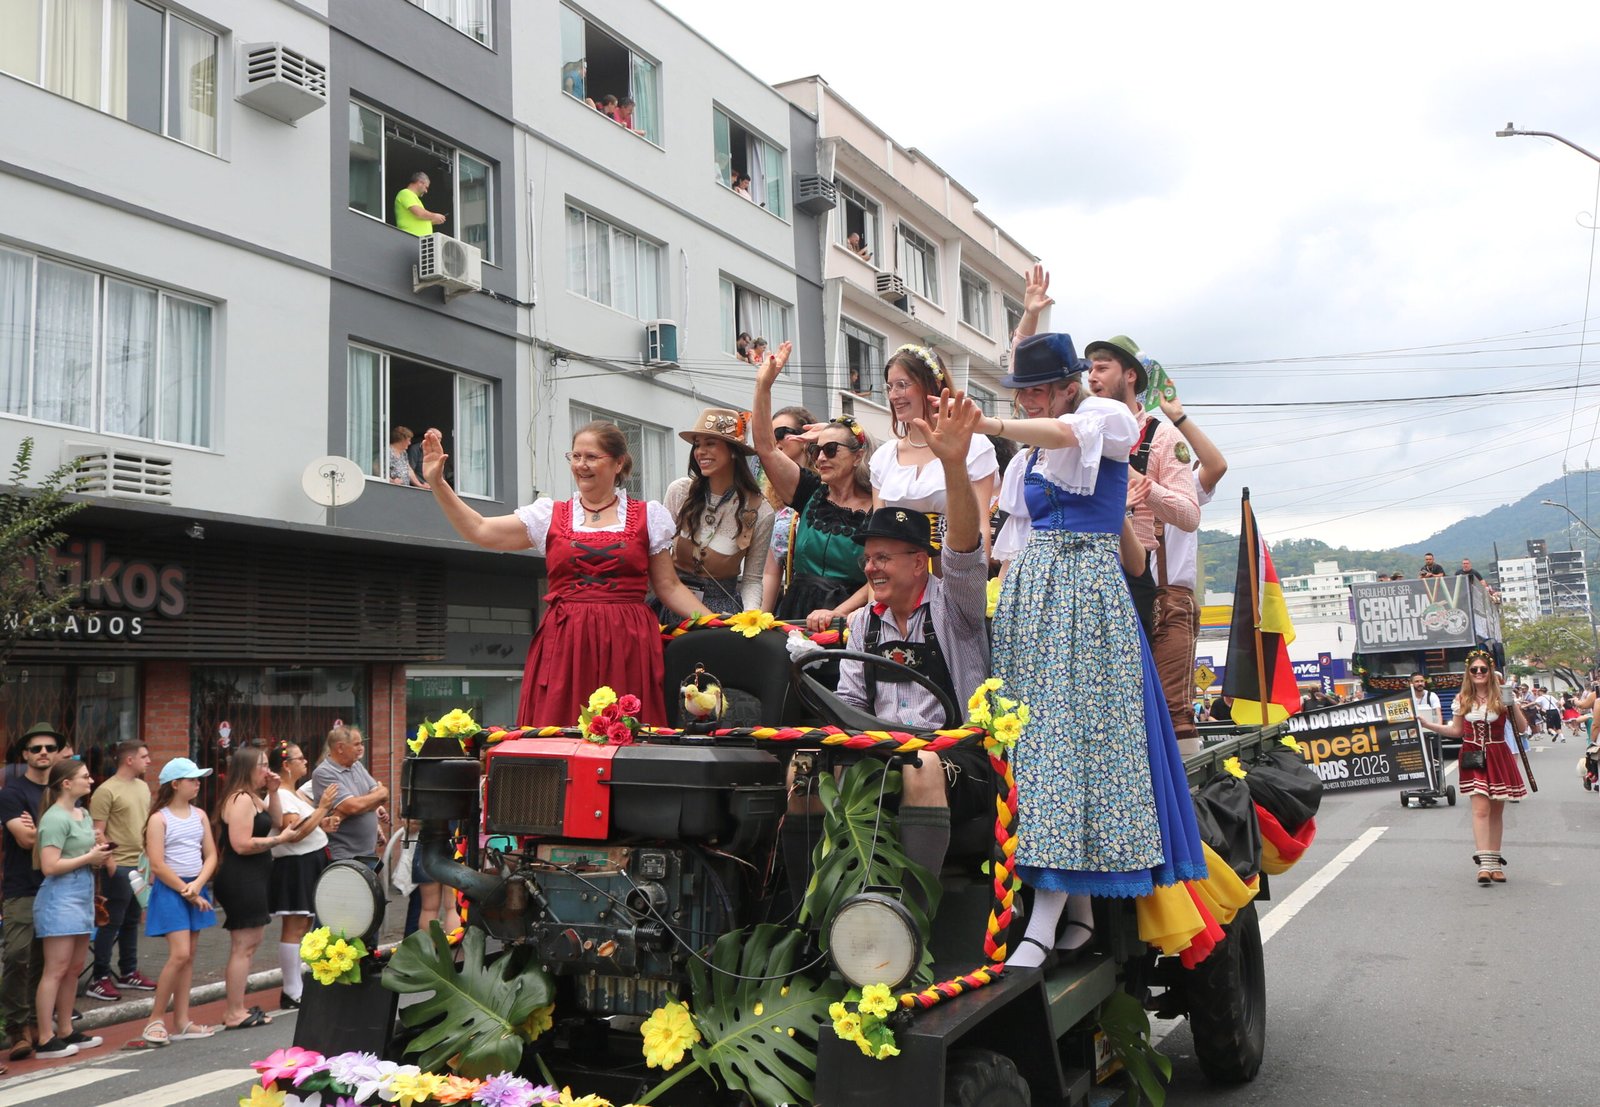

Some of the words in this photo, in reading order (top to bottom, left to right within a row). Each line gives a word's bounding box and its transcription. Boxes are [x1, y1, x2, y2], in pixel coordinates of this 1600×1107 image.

[1357, 586, 1387, 598] ORGULHO
[1387, 586, 1397, 596] DE
[1359, 594, 1430, 621] CERVEJA
[1361, 617, 1428, 644] OFICIAL!
[1292, 663, 1320, 675] nVel
[1281, 717, 1309, 734] DA
[1309, 713, 1329, 730] DO
[1329, 703, 1383, 727] BRASIL!
[1388, 707, 1410, 717] BEER
[1352, 754, 1390, 777] 2025
[1346, 778, 1369, 787] CONCURSO
